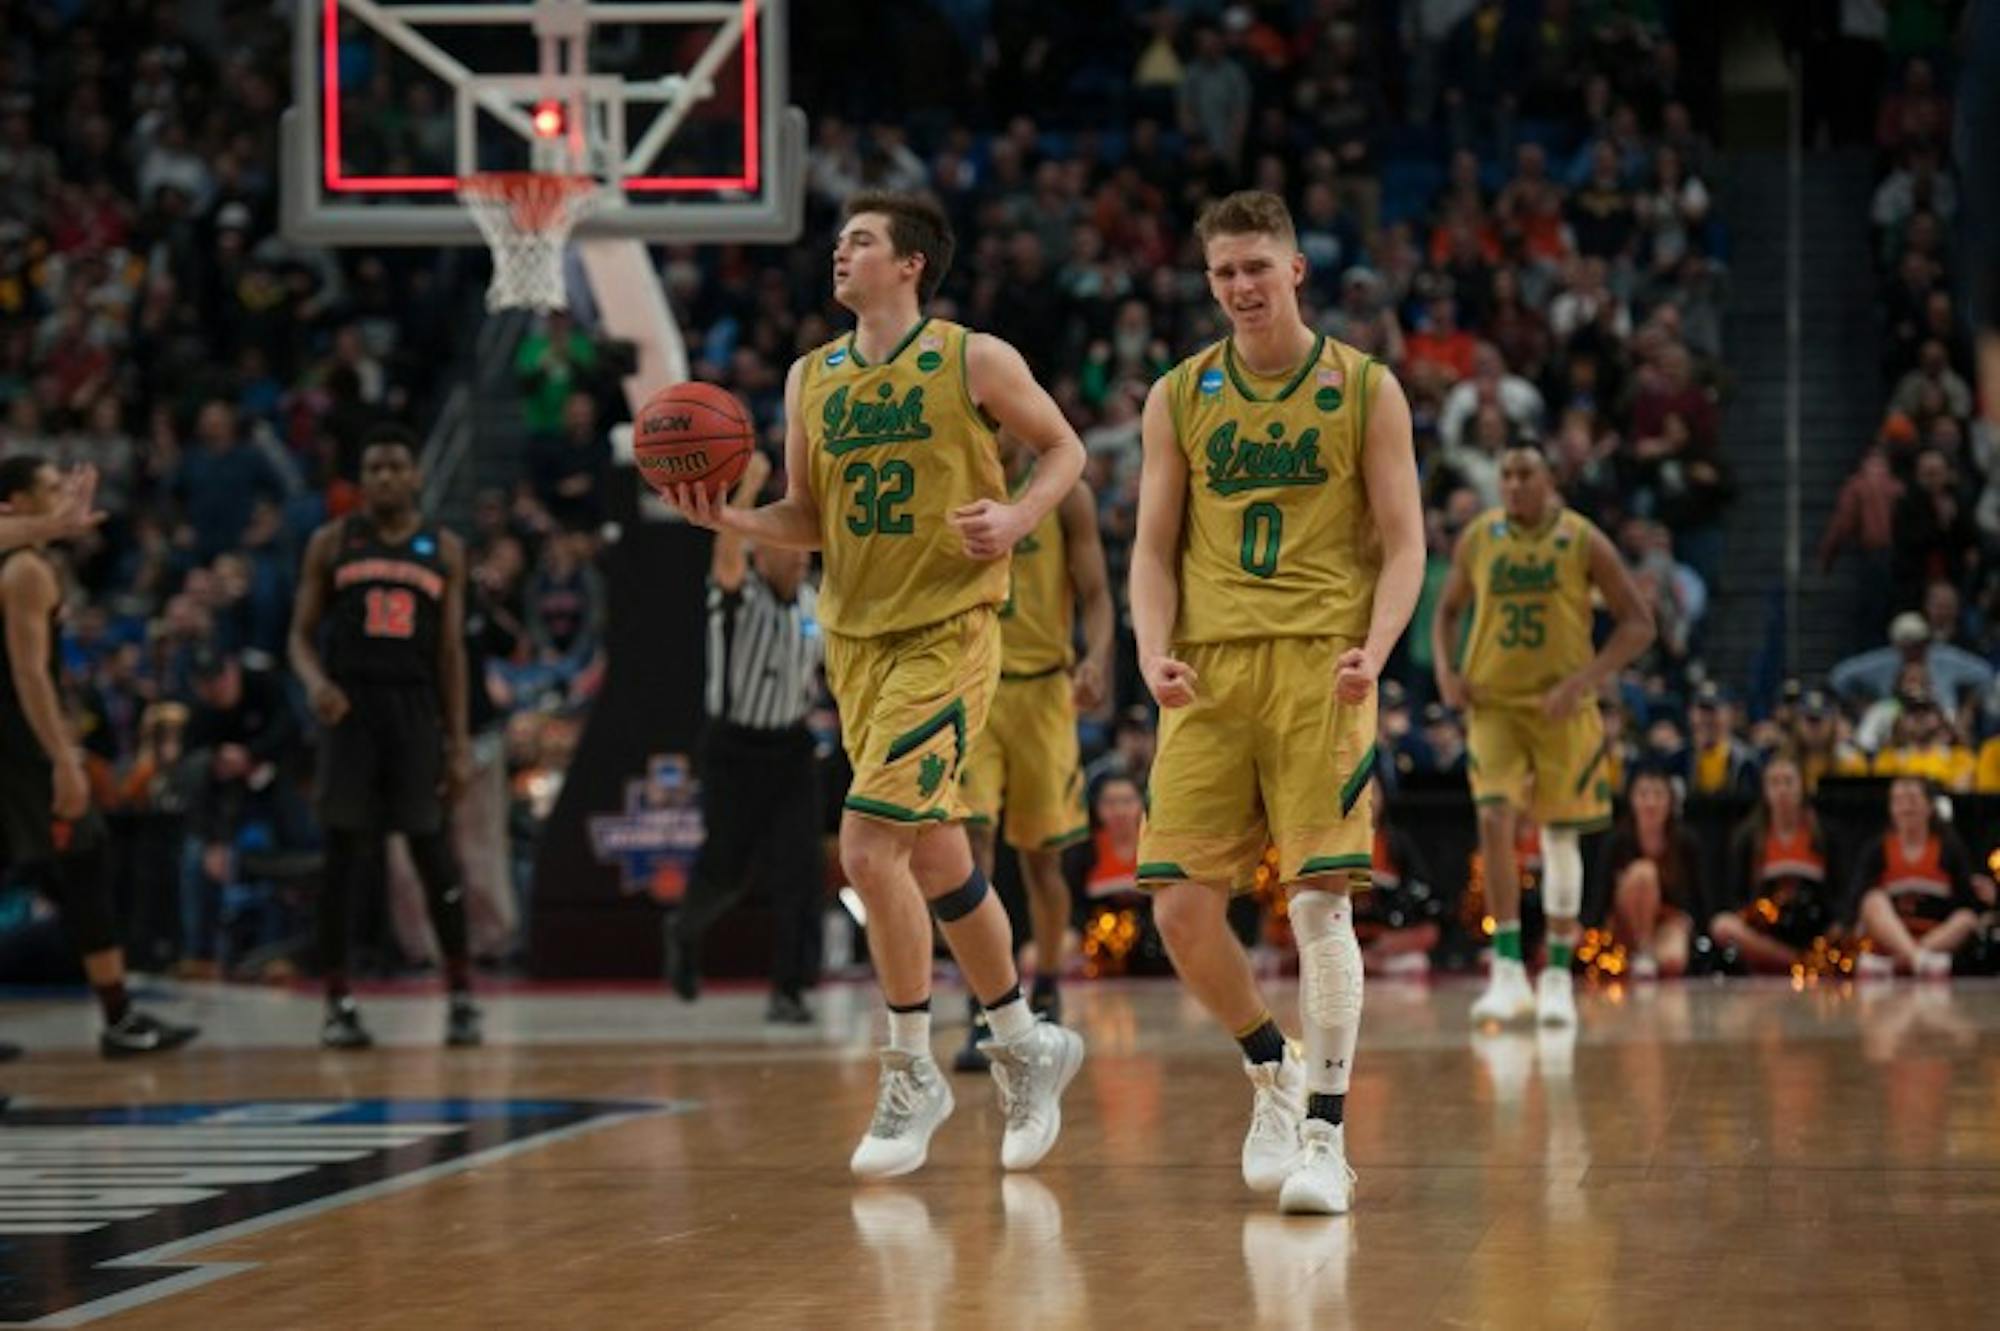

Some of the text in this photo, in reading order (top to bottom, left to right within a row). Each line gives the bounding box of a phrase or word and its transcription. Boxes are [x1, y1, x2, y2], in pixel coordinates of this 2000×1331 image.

[823, 382, 932, 454] Irish
[1205, 420, 1328, 497] Irish
[843, 460, 915, 536] 32
[1240, 502, 1283, 577] 0
[365, 588, 415, 637] 12
[1498, 602, 1547, 649] 35
